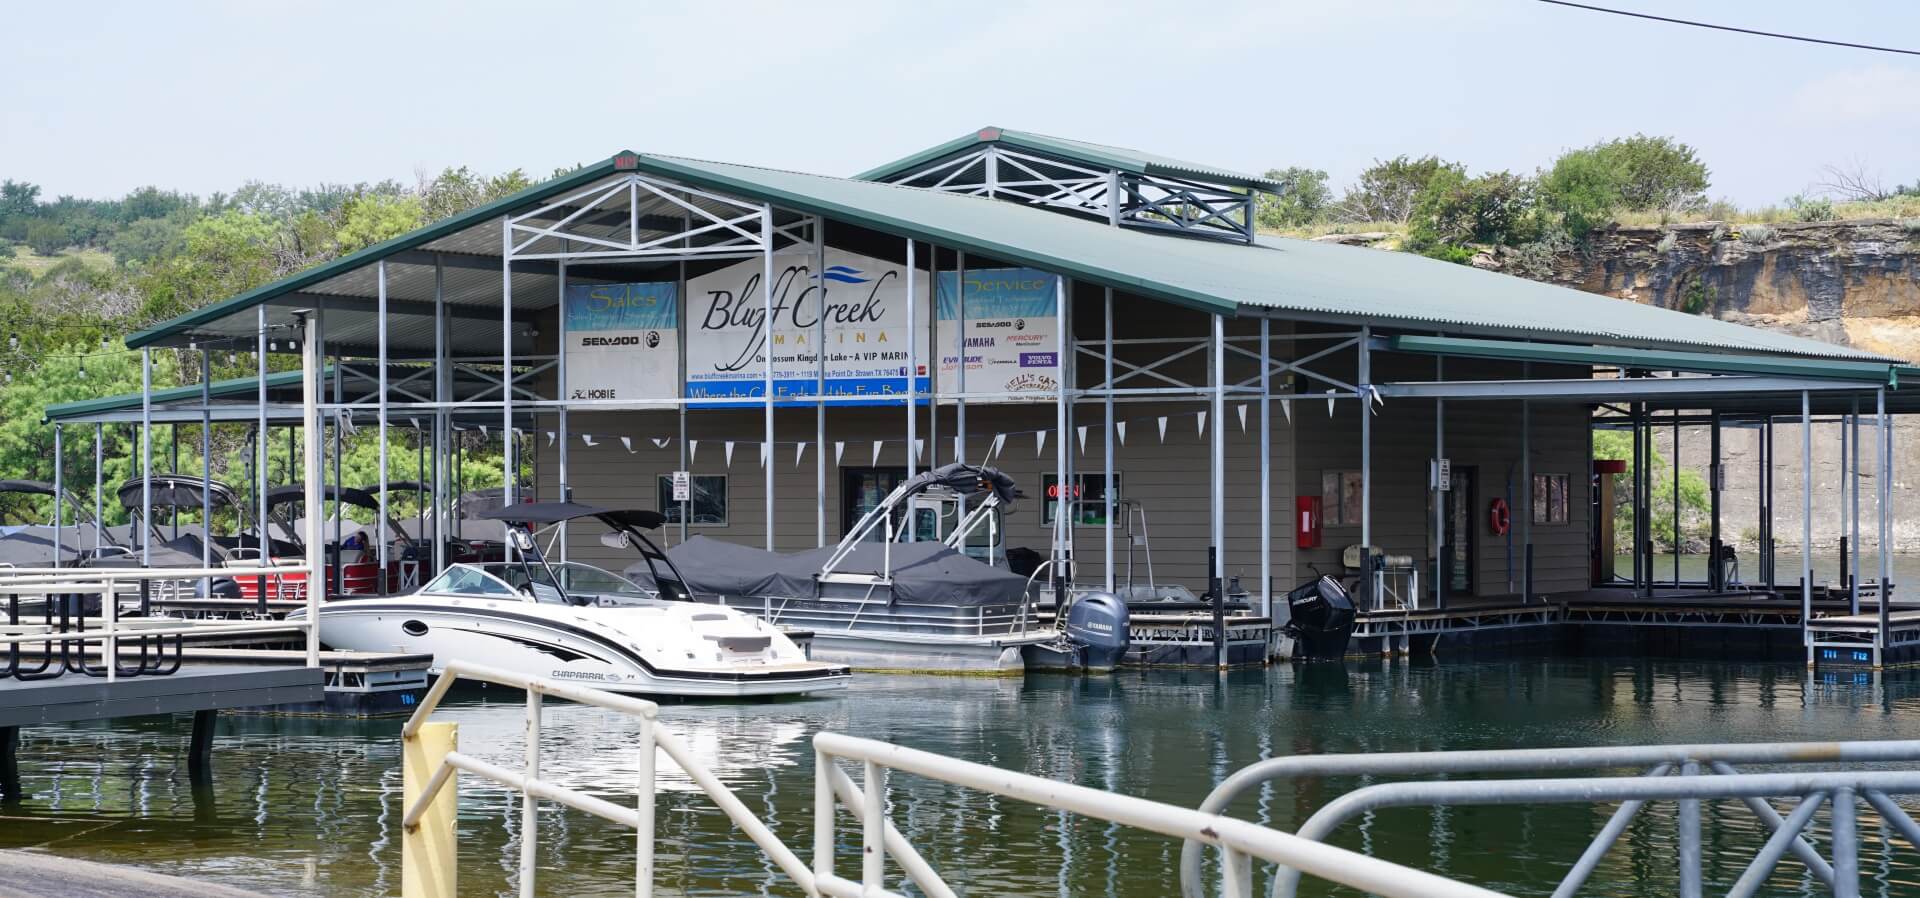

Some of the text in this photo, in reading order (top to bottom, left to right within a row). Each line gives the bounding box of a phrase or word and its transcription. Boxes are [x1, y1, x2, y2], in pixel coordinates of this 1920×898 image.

[586, 285, 657, 312] Sales
[701, 265, 897, 372] Bluff Creek
[775, 331, 888, 345] MAINA
[962, 336, 995, 347] YAMAHA
[756, 354, 766, 363] On
[771, 355, 795, 363] ossum
[797, 353, 828, 364] Kingdm
[830, 353, 847, 362] Lake
[854, 352, 860, 361] A
[863, 352, 878, 361] VIP
[881, 351, 915, 361] MARIN
[831, 369, 846, 377] Point
[1005, 373, 1035, 391] HELL'S
[588, 389, 616, 399] HOBIE
[1048, 484, 1080, 497] OEN
[552, 670, 606, 681] CHAPARRAL
